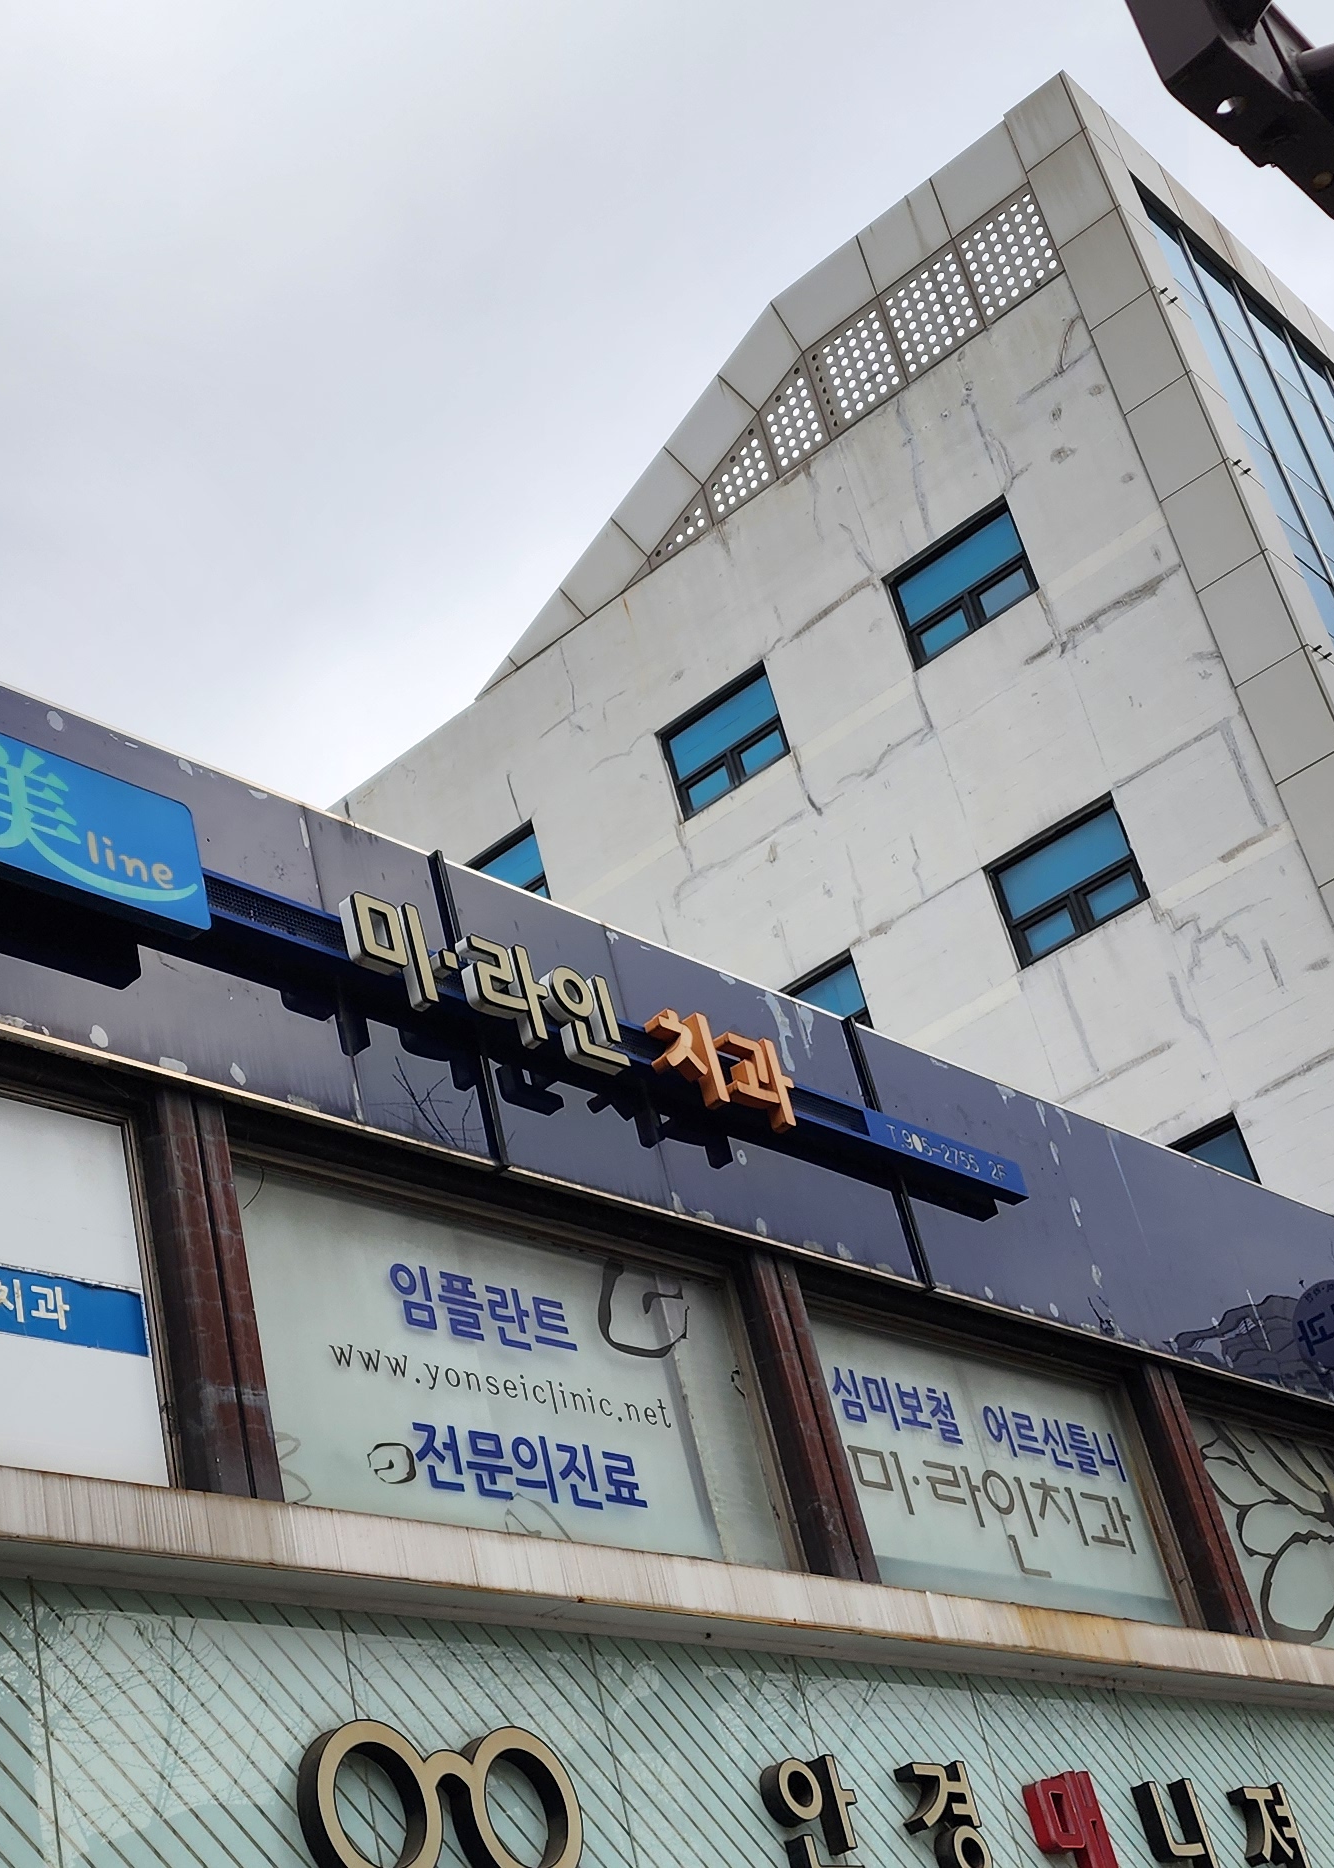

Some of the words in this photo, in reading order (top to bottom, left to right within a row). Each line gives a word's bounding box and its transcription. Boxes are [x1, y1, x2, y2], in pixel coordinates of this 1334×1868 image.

[88, 830, 175, 890] line
[644, 1008, 796, 1133] 치과
[389, 1262, 578, 1352] 임플란트
[329, 1341, 672, 1429] www.yonseiclinic.net
[831, 1366, 963, 1446] 심미보철
[982, 1404, 1126, 1484] 어르신틀니
[412, 1421, 649, 1511] 전문의진료
